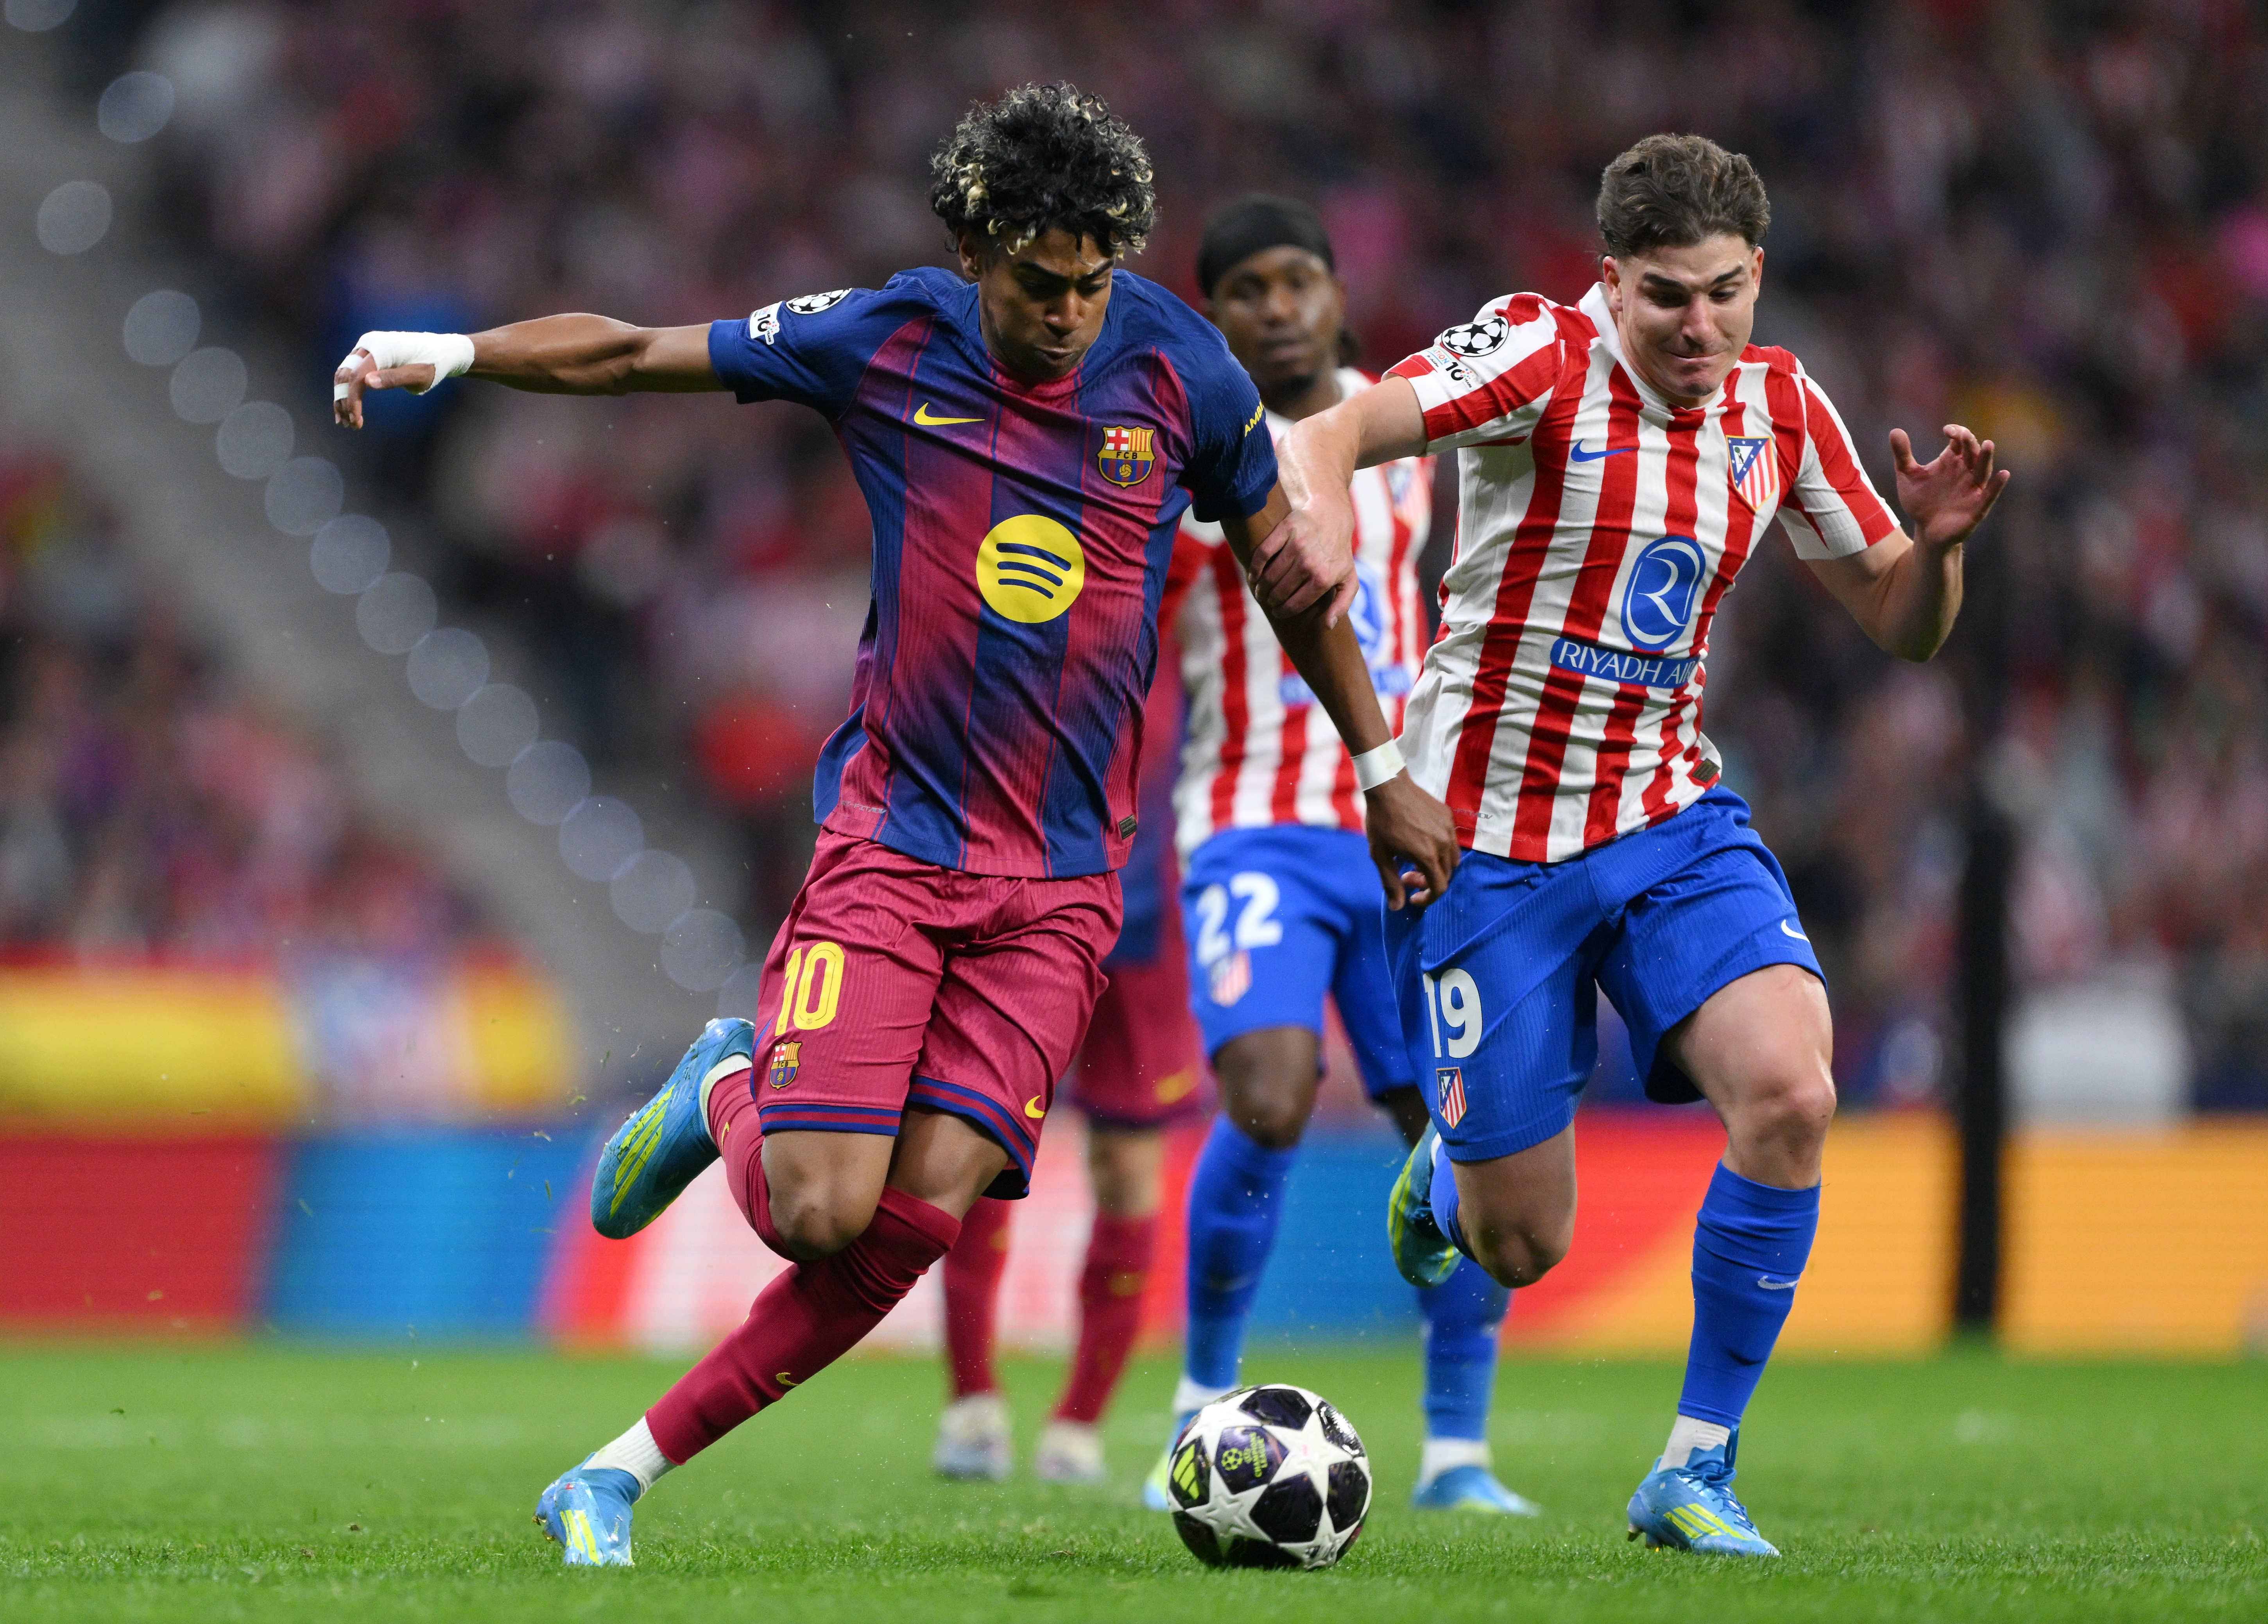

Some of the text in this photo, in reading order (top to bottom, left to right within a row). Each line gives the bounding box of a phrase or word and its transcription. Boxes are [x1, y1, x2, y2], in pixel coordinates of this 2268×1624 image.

[1428, 347, 1450, 364] ATION
[1445, 362, 1472, 388] 10 YEARS
[1245, 401, 1264, 437] AMBI
[1116, 451, 1138, 459] FCB
[1558, 641, 1696, 684] RIYADH AIR
[1196, 871, 1283, 968] 22
[775, 942, 845, 1037] 10
[1423, 968, 1483, 1058] 19
